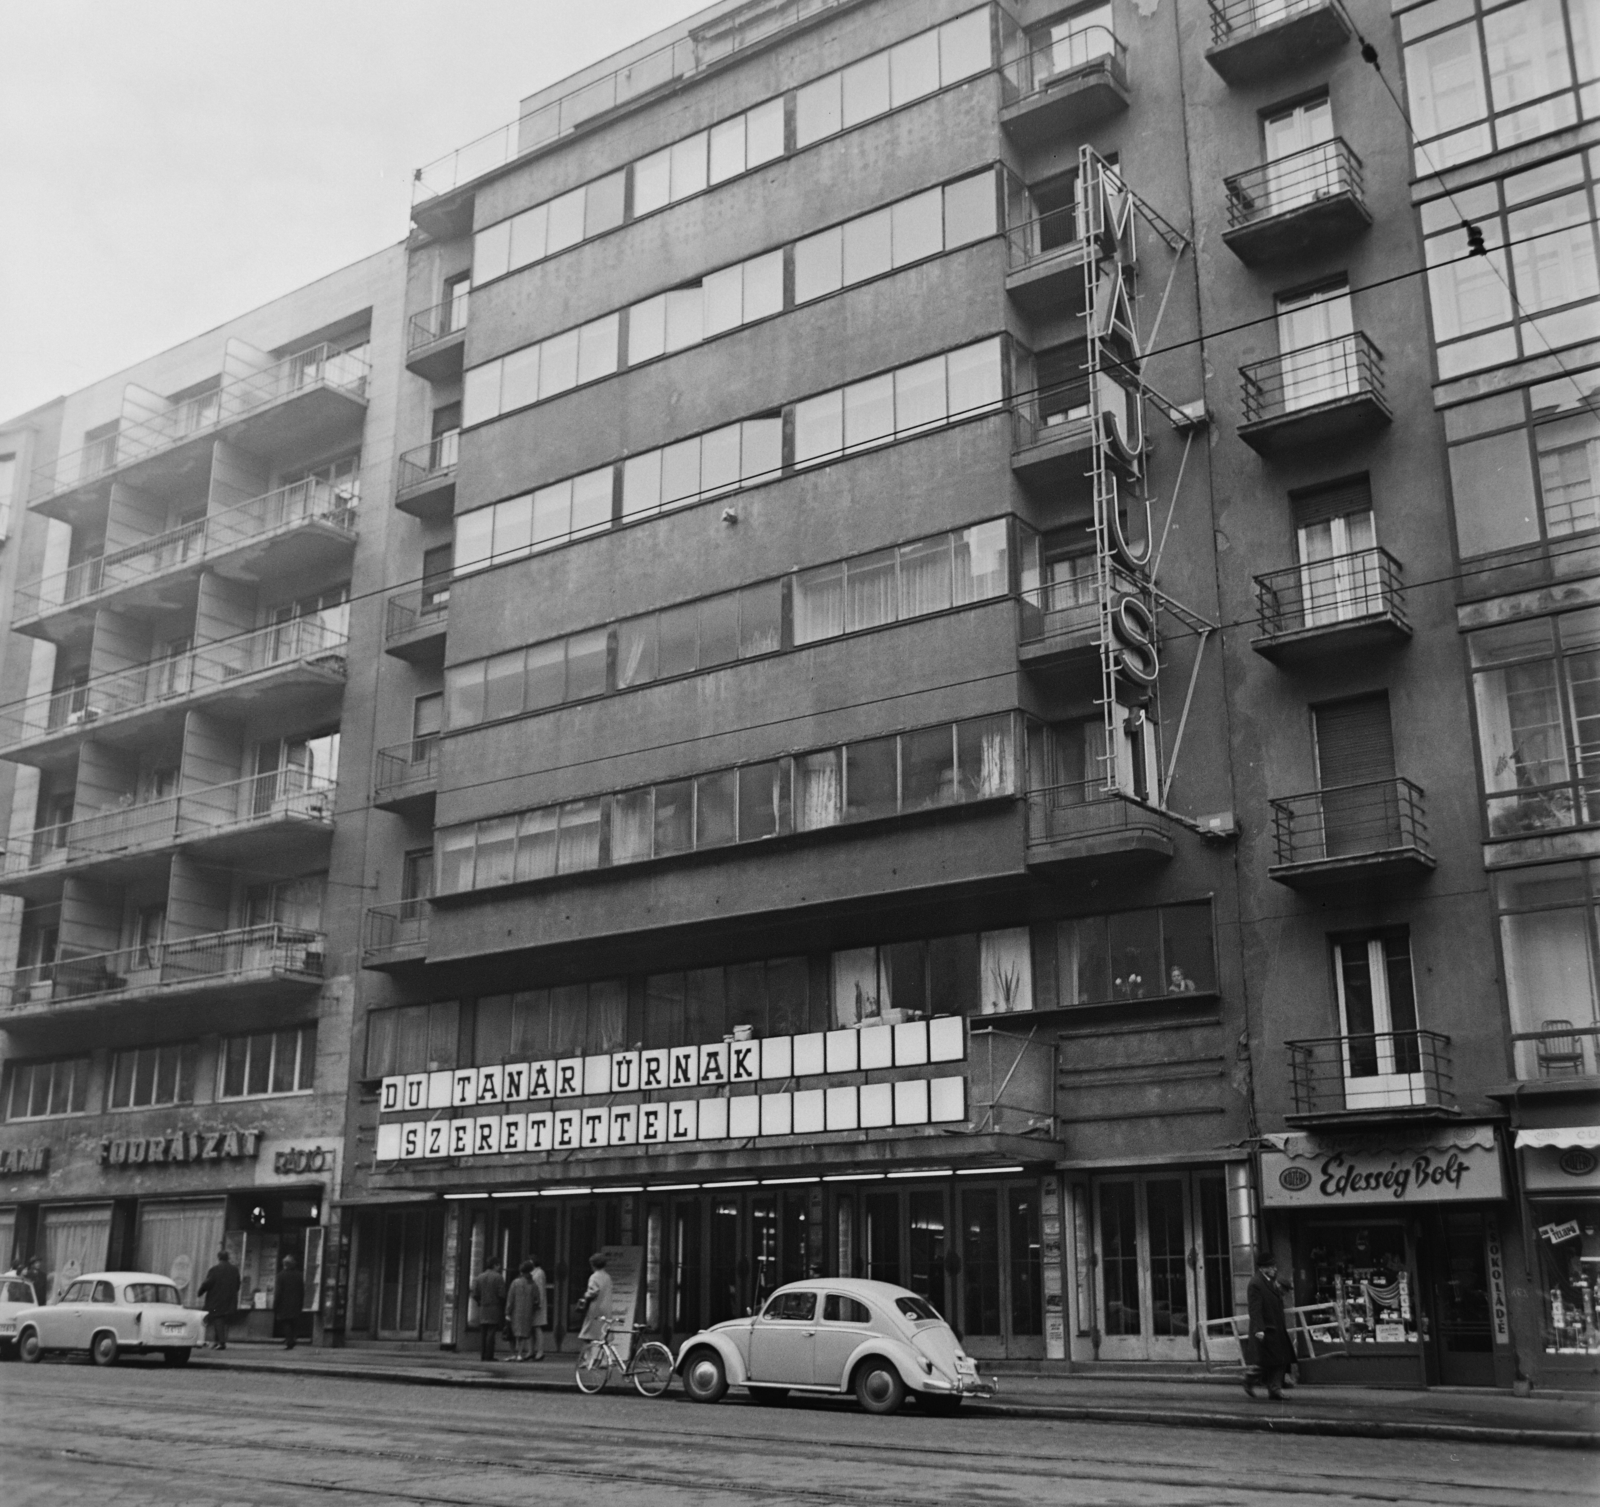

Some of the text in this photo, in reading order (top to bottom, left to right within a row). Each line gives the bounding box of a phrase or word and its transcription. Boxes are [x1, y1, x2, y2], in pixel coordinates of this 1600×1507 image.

[383, 1047, 753, 1109] DU TANÁR ÚRNAK
[405, 1108, 688, 1157] SZERETETTEL
[274, 1145, 325, 1175] RÁDIÓ
[1411, 1152, 1471, 1190] Bolt
